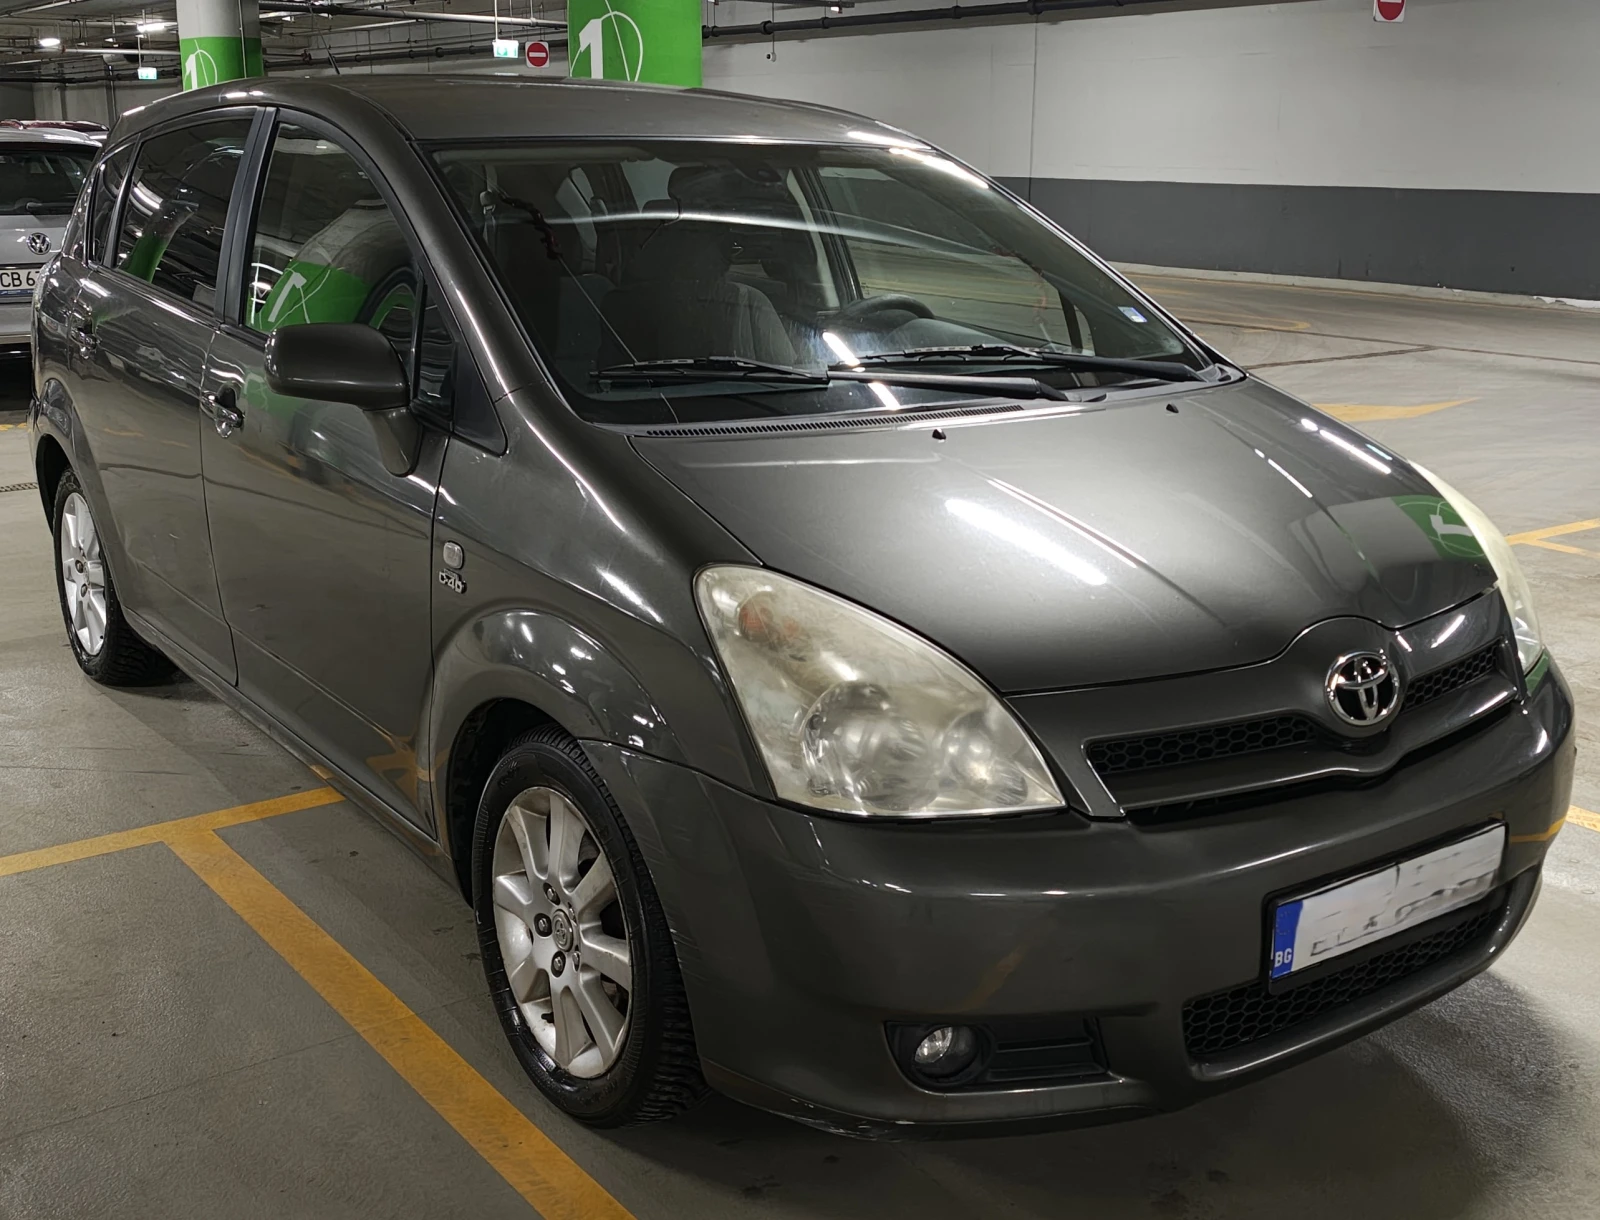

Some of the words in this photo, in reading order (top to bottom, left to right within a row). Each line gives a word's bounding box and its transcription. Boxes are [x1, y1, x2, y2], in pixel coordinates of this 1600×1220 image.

[579, 18, 603, 79] 1
[186, 54, 197, 90] 1
[0, 272, 22, 287] CB
[26, 271, 40, 286] 6
[1275, 948, 1292, 967] BG
